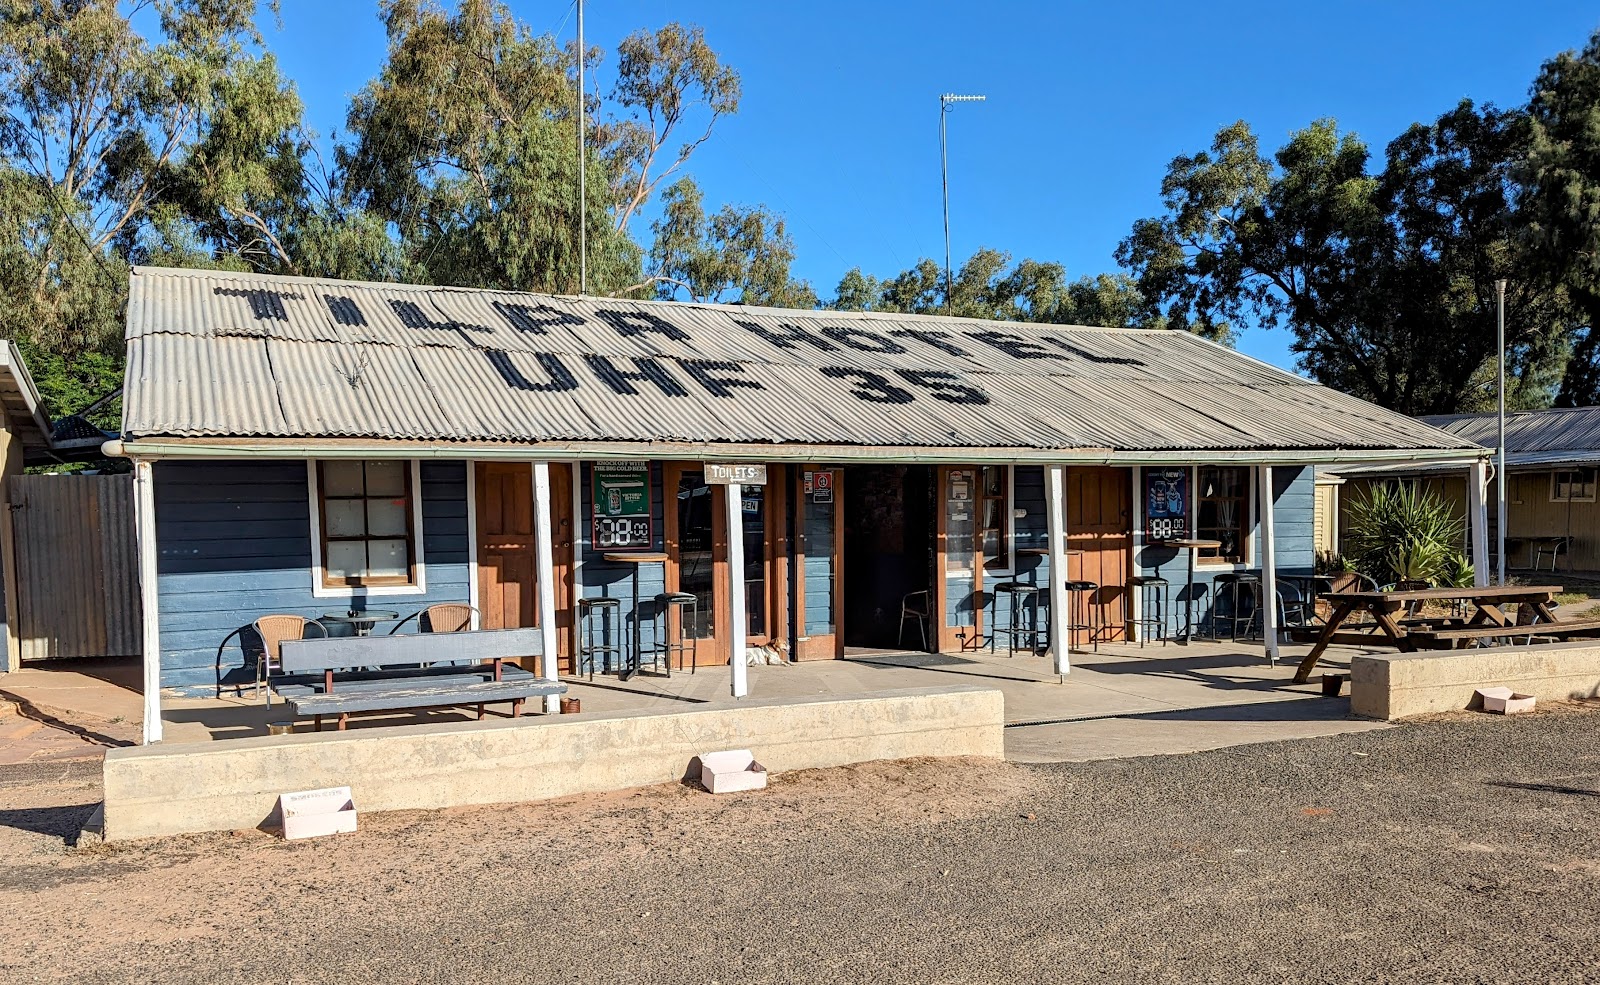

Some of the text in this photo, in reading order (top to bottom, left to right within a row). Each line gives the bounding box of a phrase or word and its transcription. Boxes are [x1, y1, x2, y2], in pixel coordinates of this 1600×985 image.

[213, 287, 1149, 366] TILPA HOTEL
[485, 349, 990, 405] UHF 35
[711, 465, 755, 478] TOILETS
[742, 501, 756, 510] PEN
